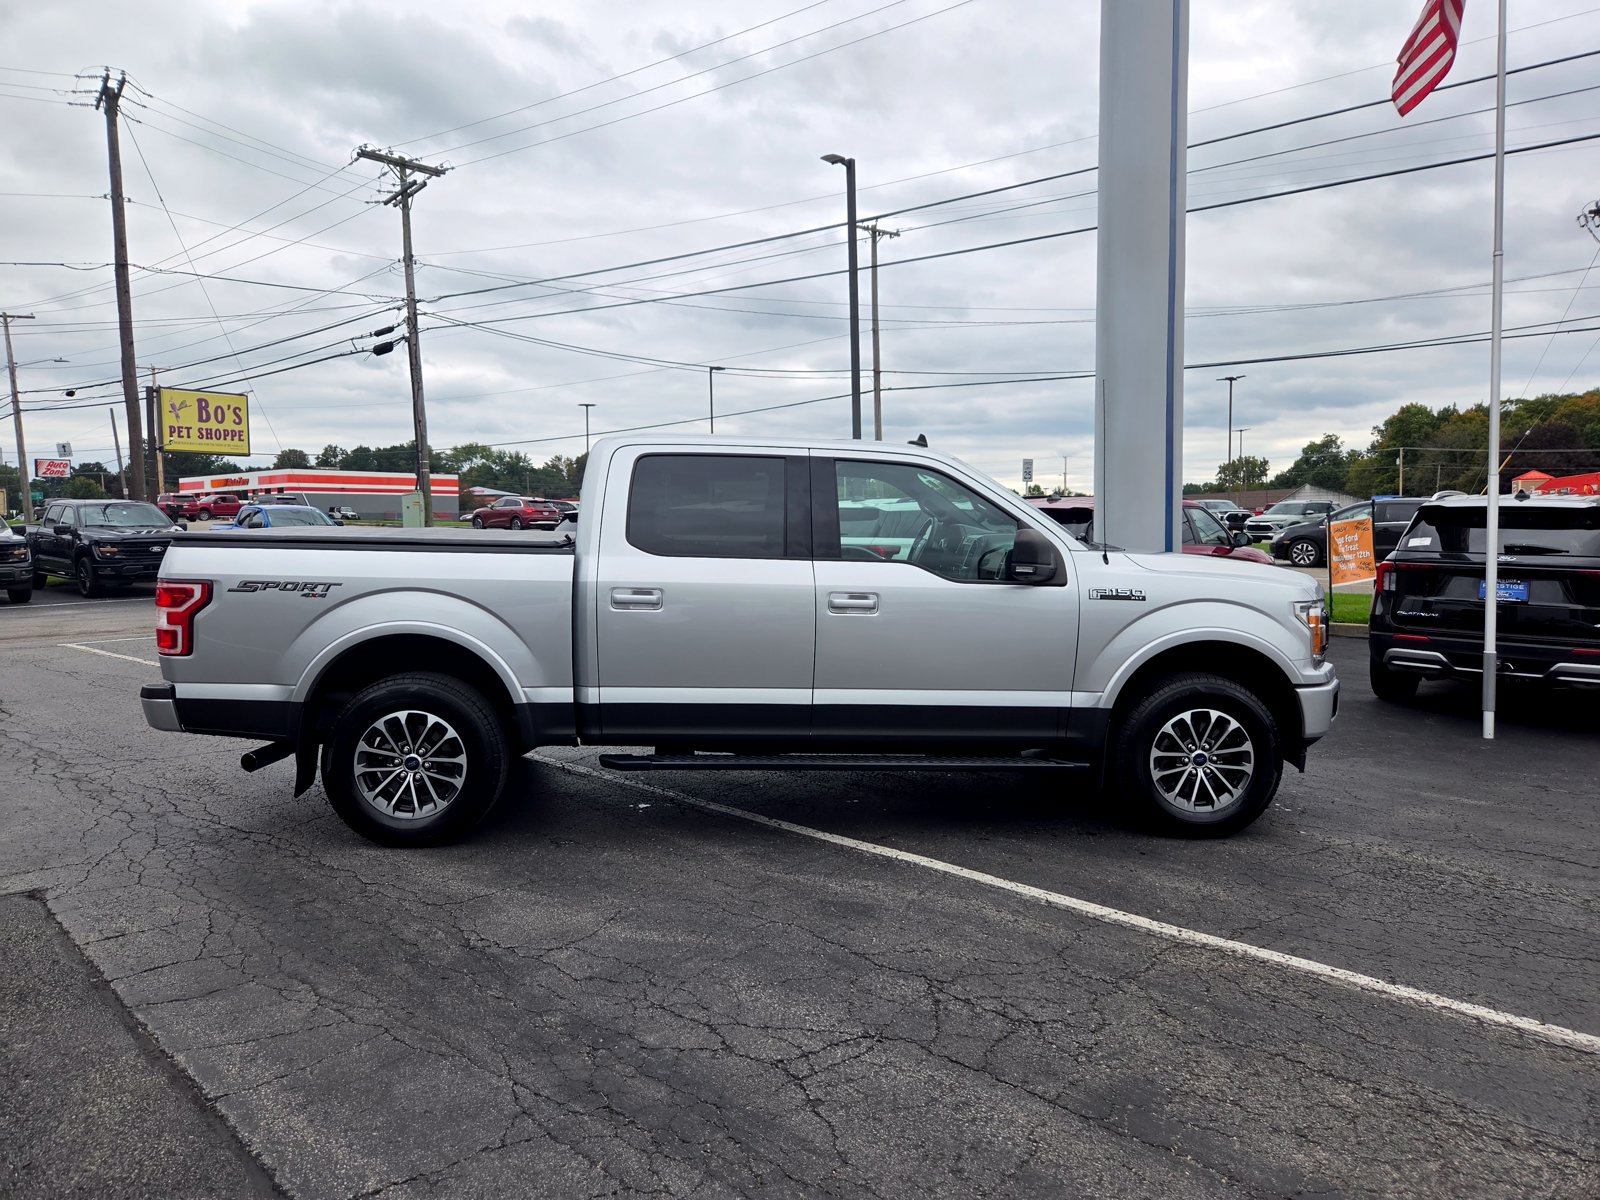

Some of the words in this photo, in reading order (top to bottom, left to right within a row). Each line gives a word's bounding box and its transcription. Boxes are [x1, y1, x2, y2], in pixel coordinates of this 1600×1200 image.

[196, 398, 243, 425] Bo's
[168, 425, 193, 438] PET
[197, 427, 244, 441] SHOPPE
[46, 460, 69, 469] Auto
[42, 467, 65, 477] Zone
[1023, 471, 1032, 479] 25
[1345, 533, 1358, 542] Ford
[1345, 543, 1359, 551] Treat
[1357, 550, 1371, 559] 12th
[227, 580, 343, 593] SPORT
